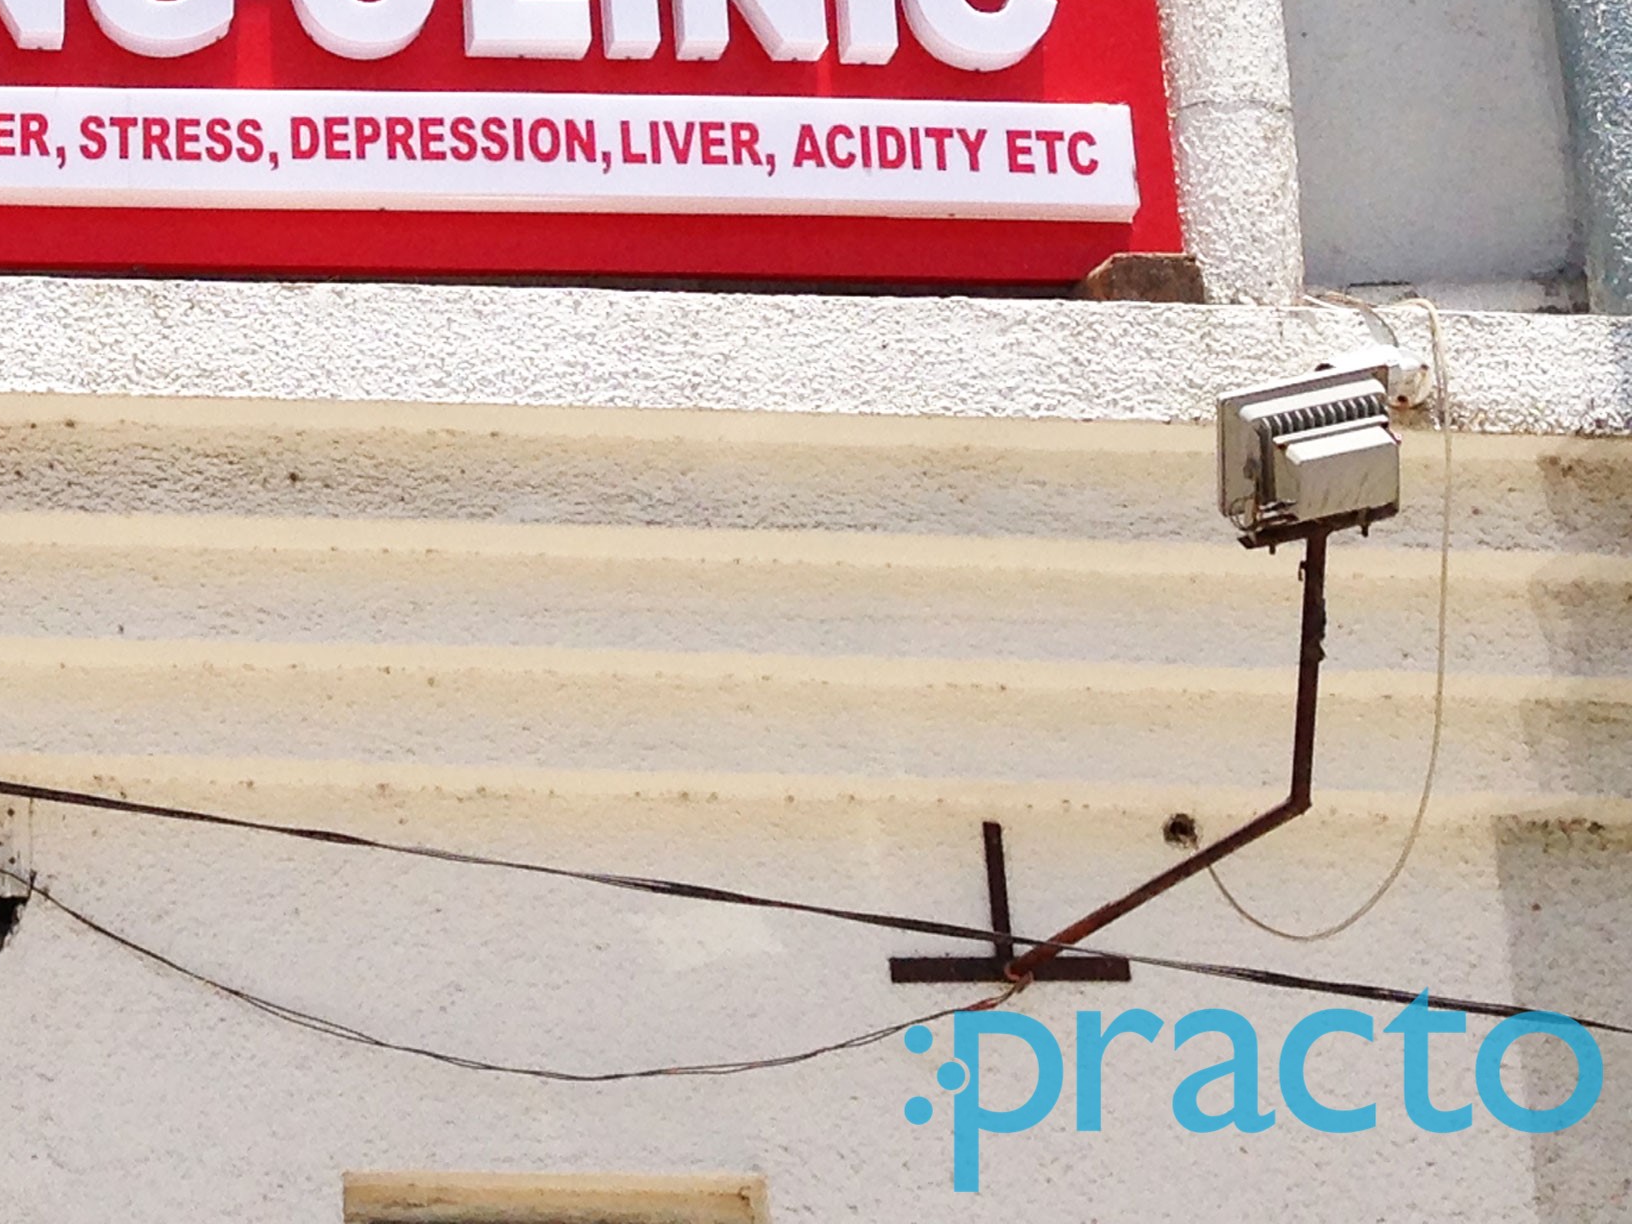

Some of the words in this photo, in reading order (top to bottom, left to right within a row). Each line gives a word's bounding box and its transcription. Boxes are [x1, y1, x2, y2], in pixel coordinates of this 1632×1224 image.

[80, 116, 278, 168] STRESS,
[291, 117, 611, 171] DEPRESSION,
[621, 121, 775, 175] LIVER,
[794, 124, 987, 171] ACIDITY
[1006, 130, 1098, 175] ETC
